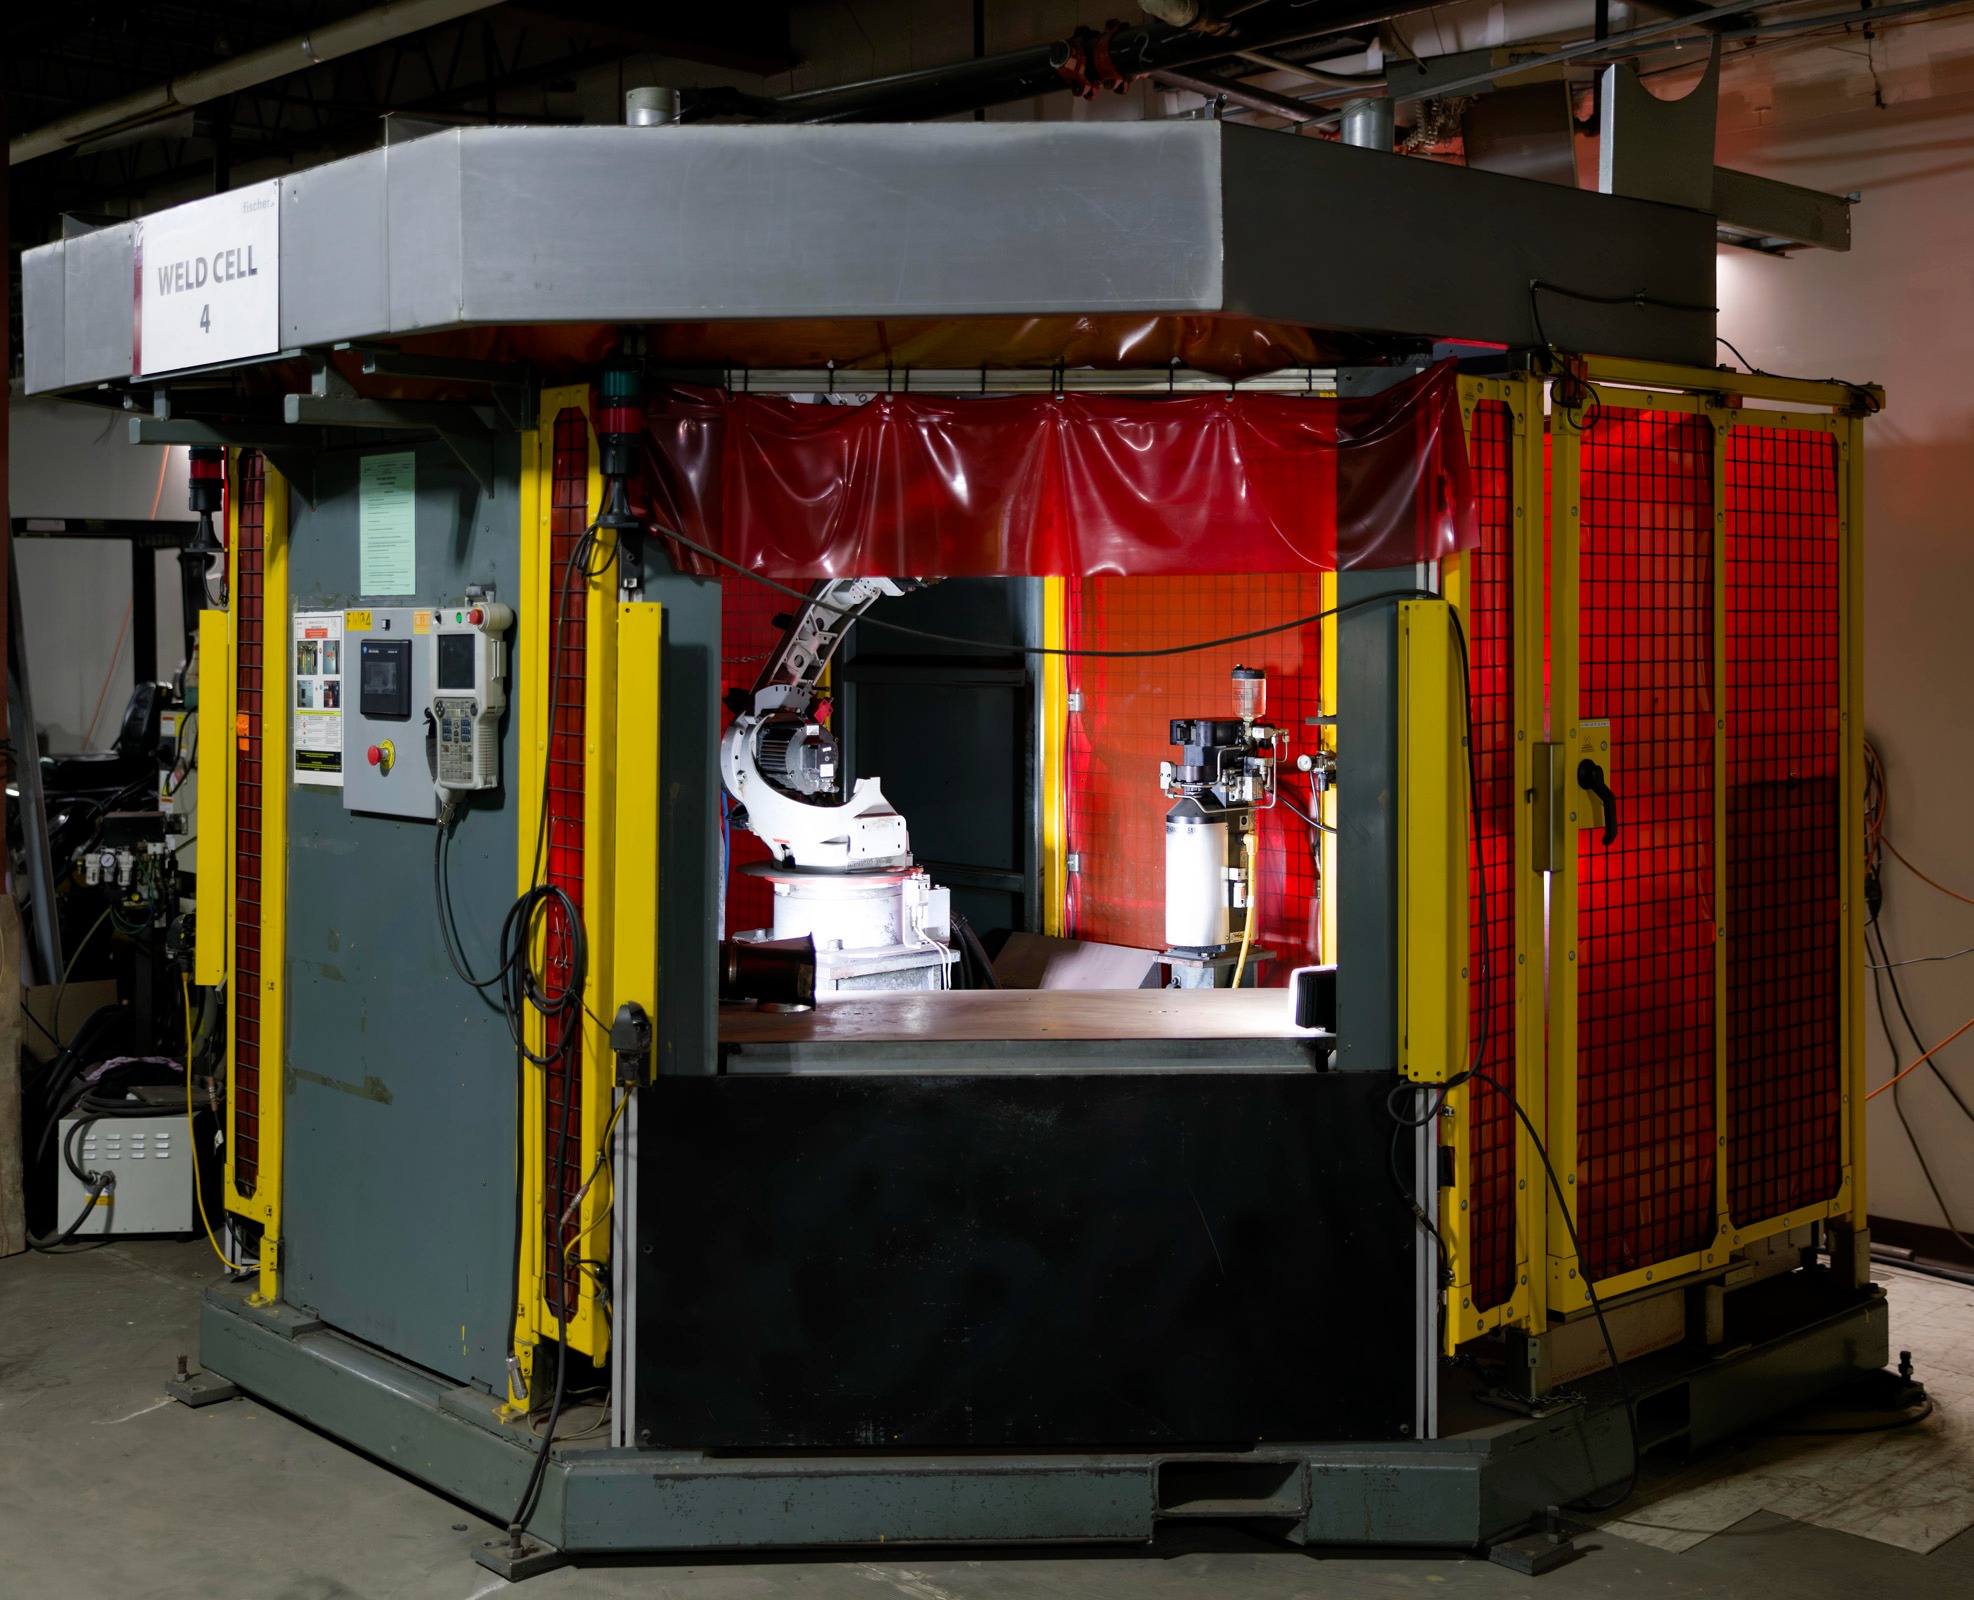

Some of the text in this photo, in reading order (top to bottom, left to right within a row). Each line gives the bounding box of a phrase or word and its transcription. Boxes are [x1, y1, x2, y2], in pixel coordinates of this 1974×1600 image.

[243, 198, 270, 214] fischer
[158, 245, 258, 296] WELD CELL
[200, 304, 211, 333] 4
